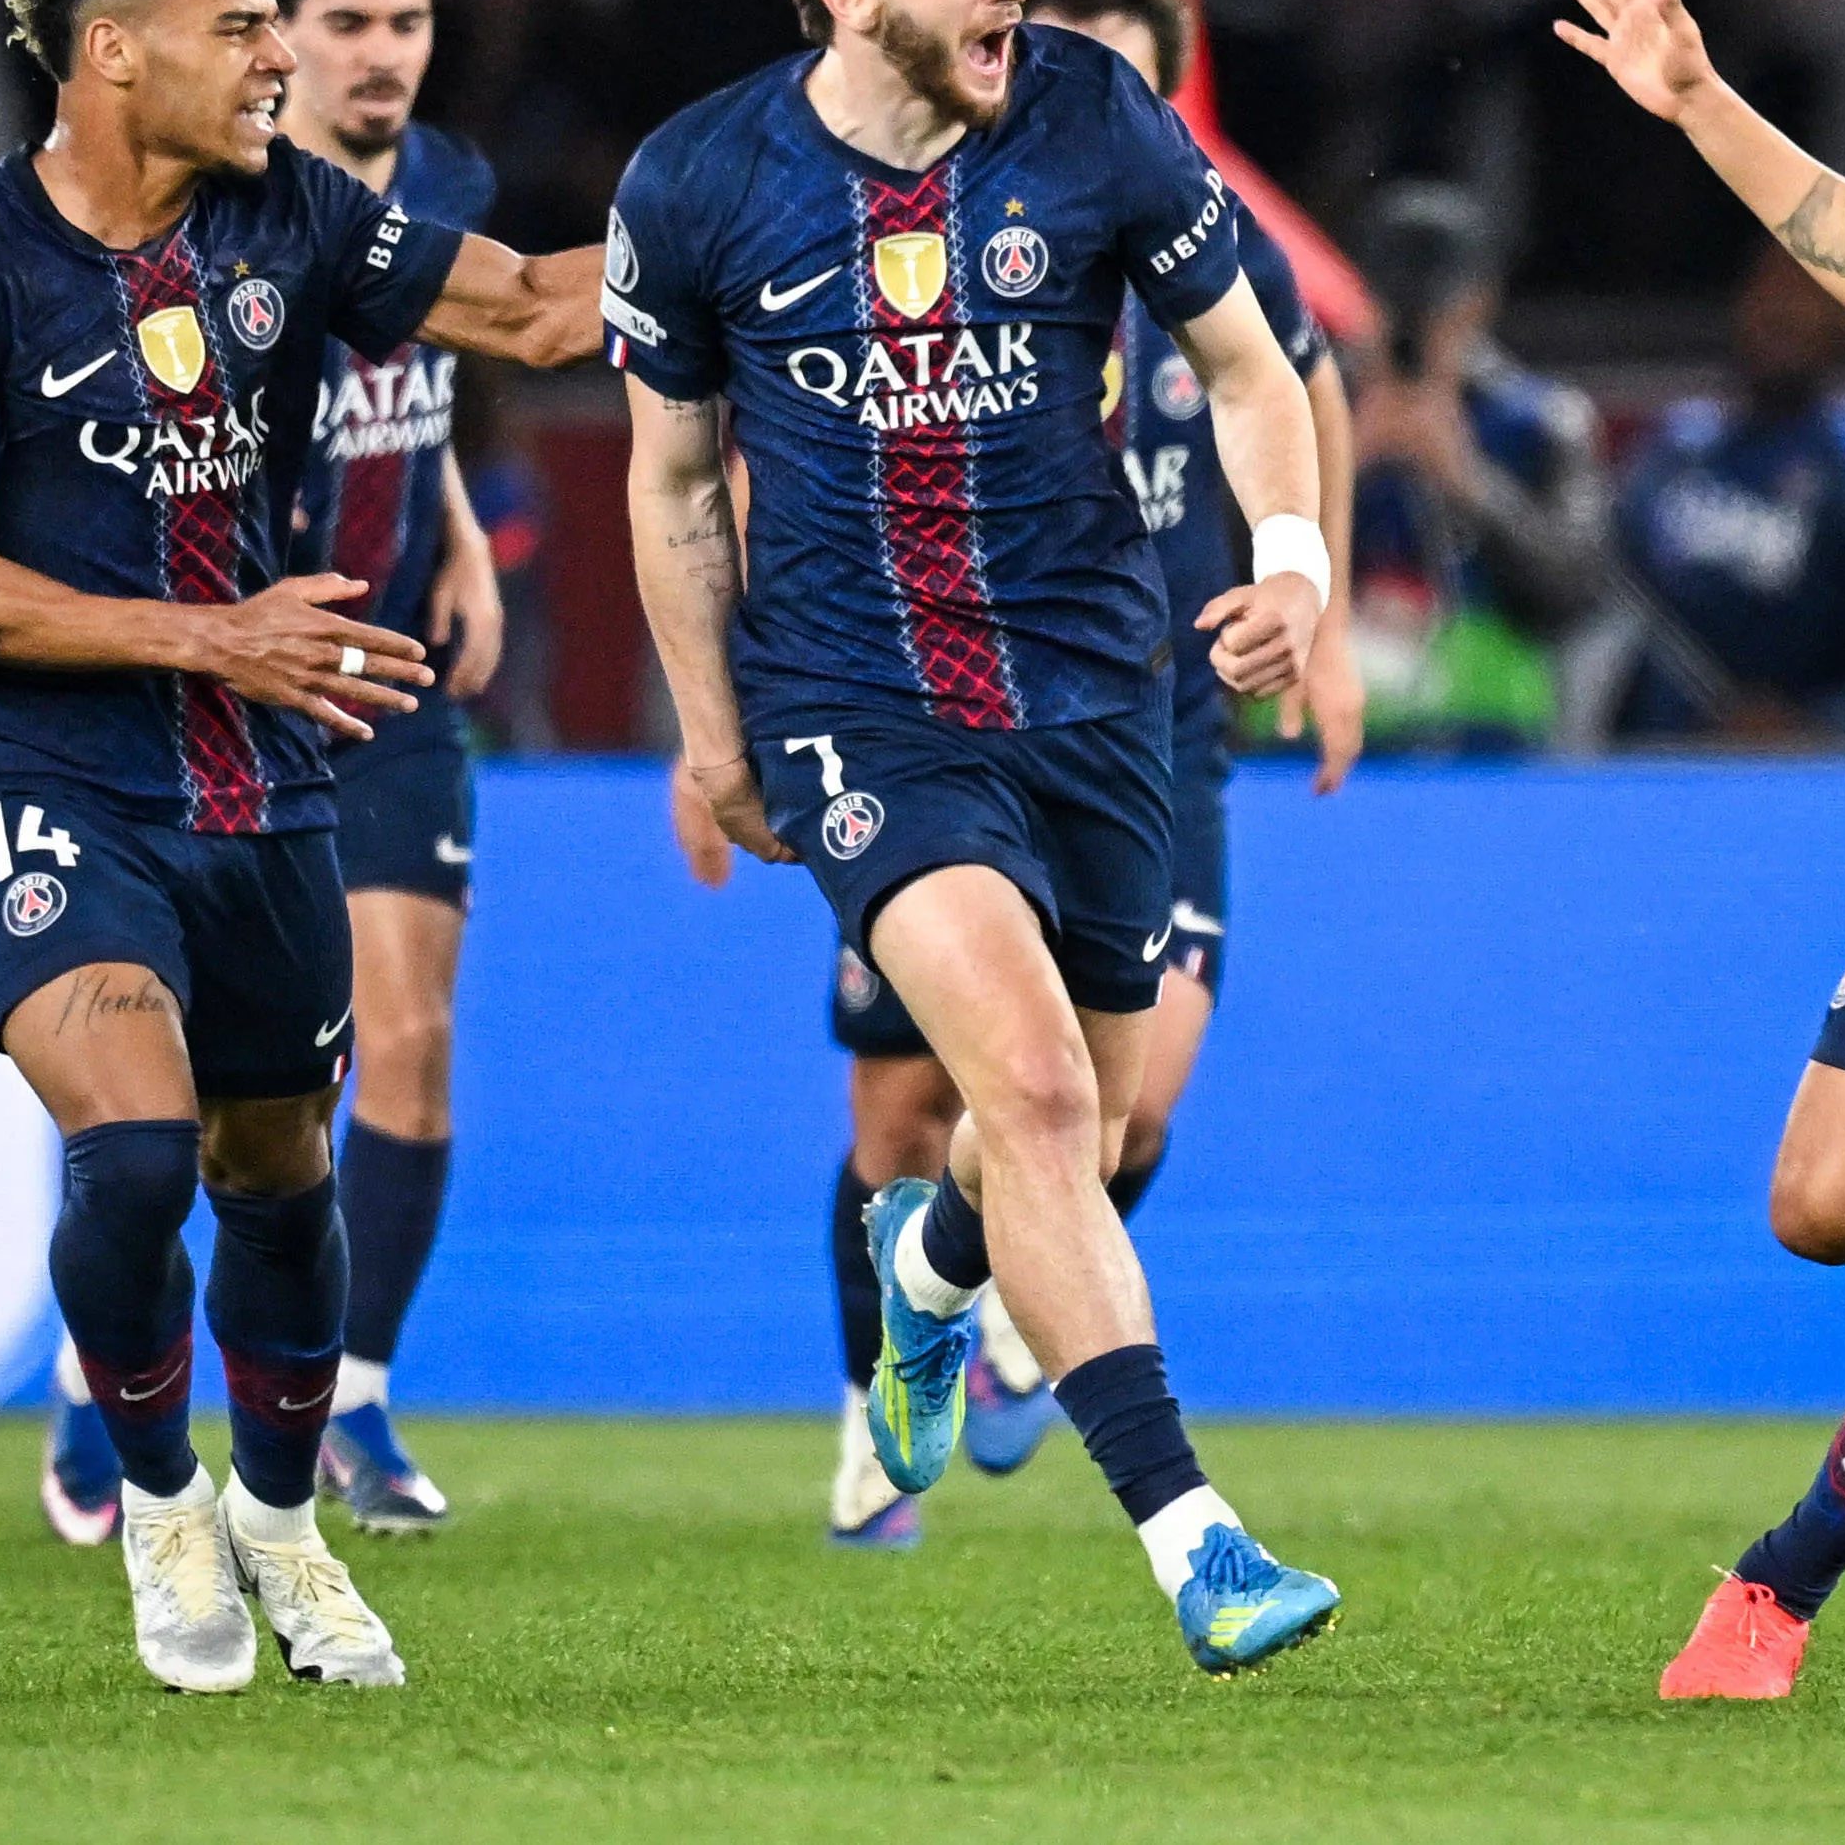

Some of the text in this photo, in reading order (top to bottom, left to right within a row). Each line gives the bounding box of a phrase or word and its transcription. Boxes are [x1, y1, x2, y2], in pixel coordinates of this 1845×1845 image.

[992, 230, 1036, 251] PARIS
[234, 283, 269, 306] PARIS
[786, 322, 1037, 408] QATAR
[859, 372, 1039, 431] AIRWAYS
[783, 734, 845, 797] 7
[826, 796, 863, 828] PARIS
[9, 876, 51, 901] PARIS
